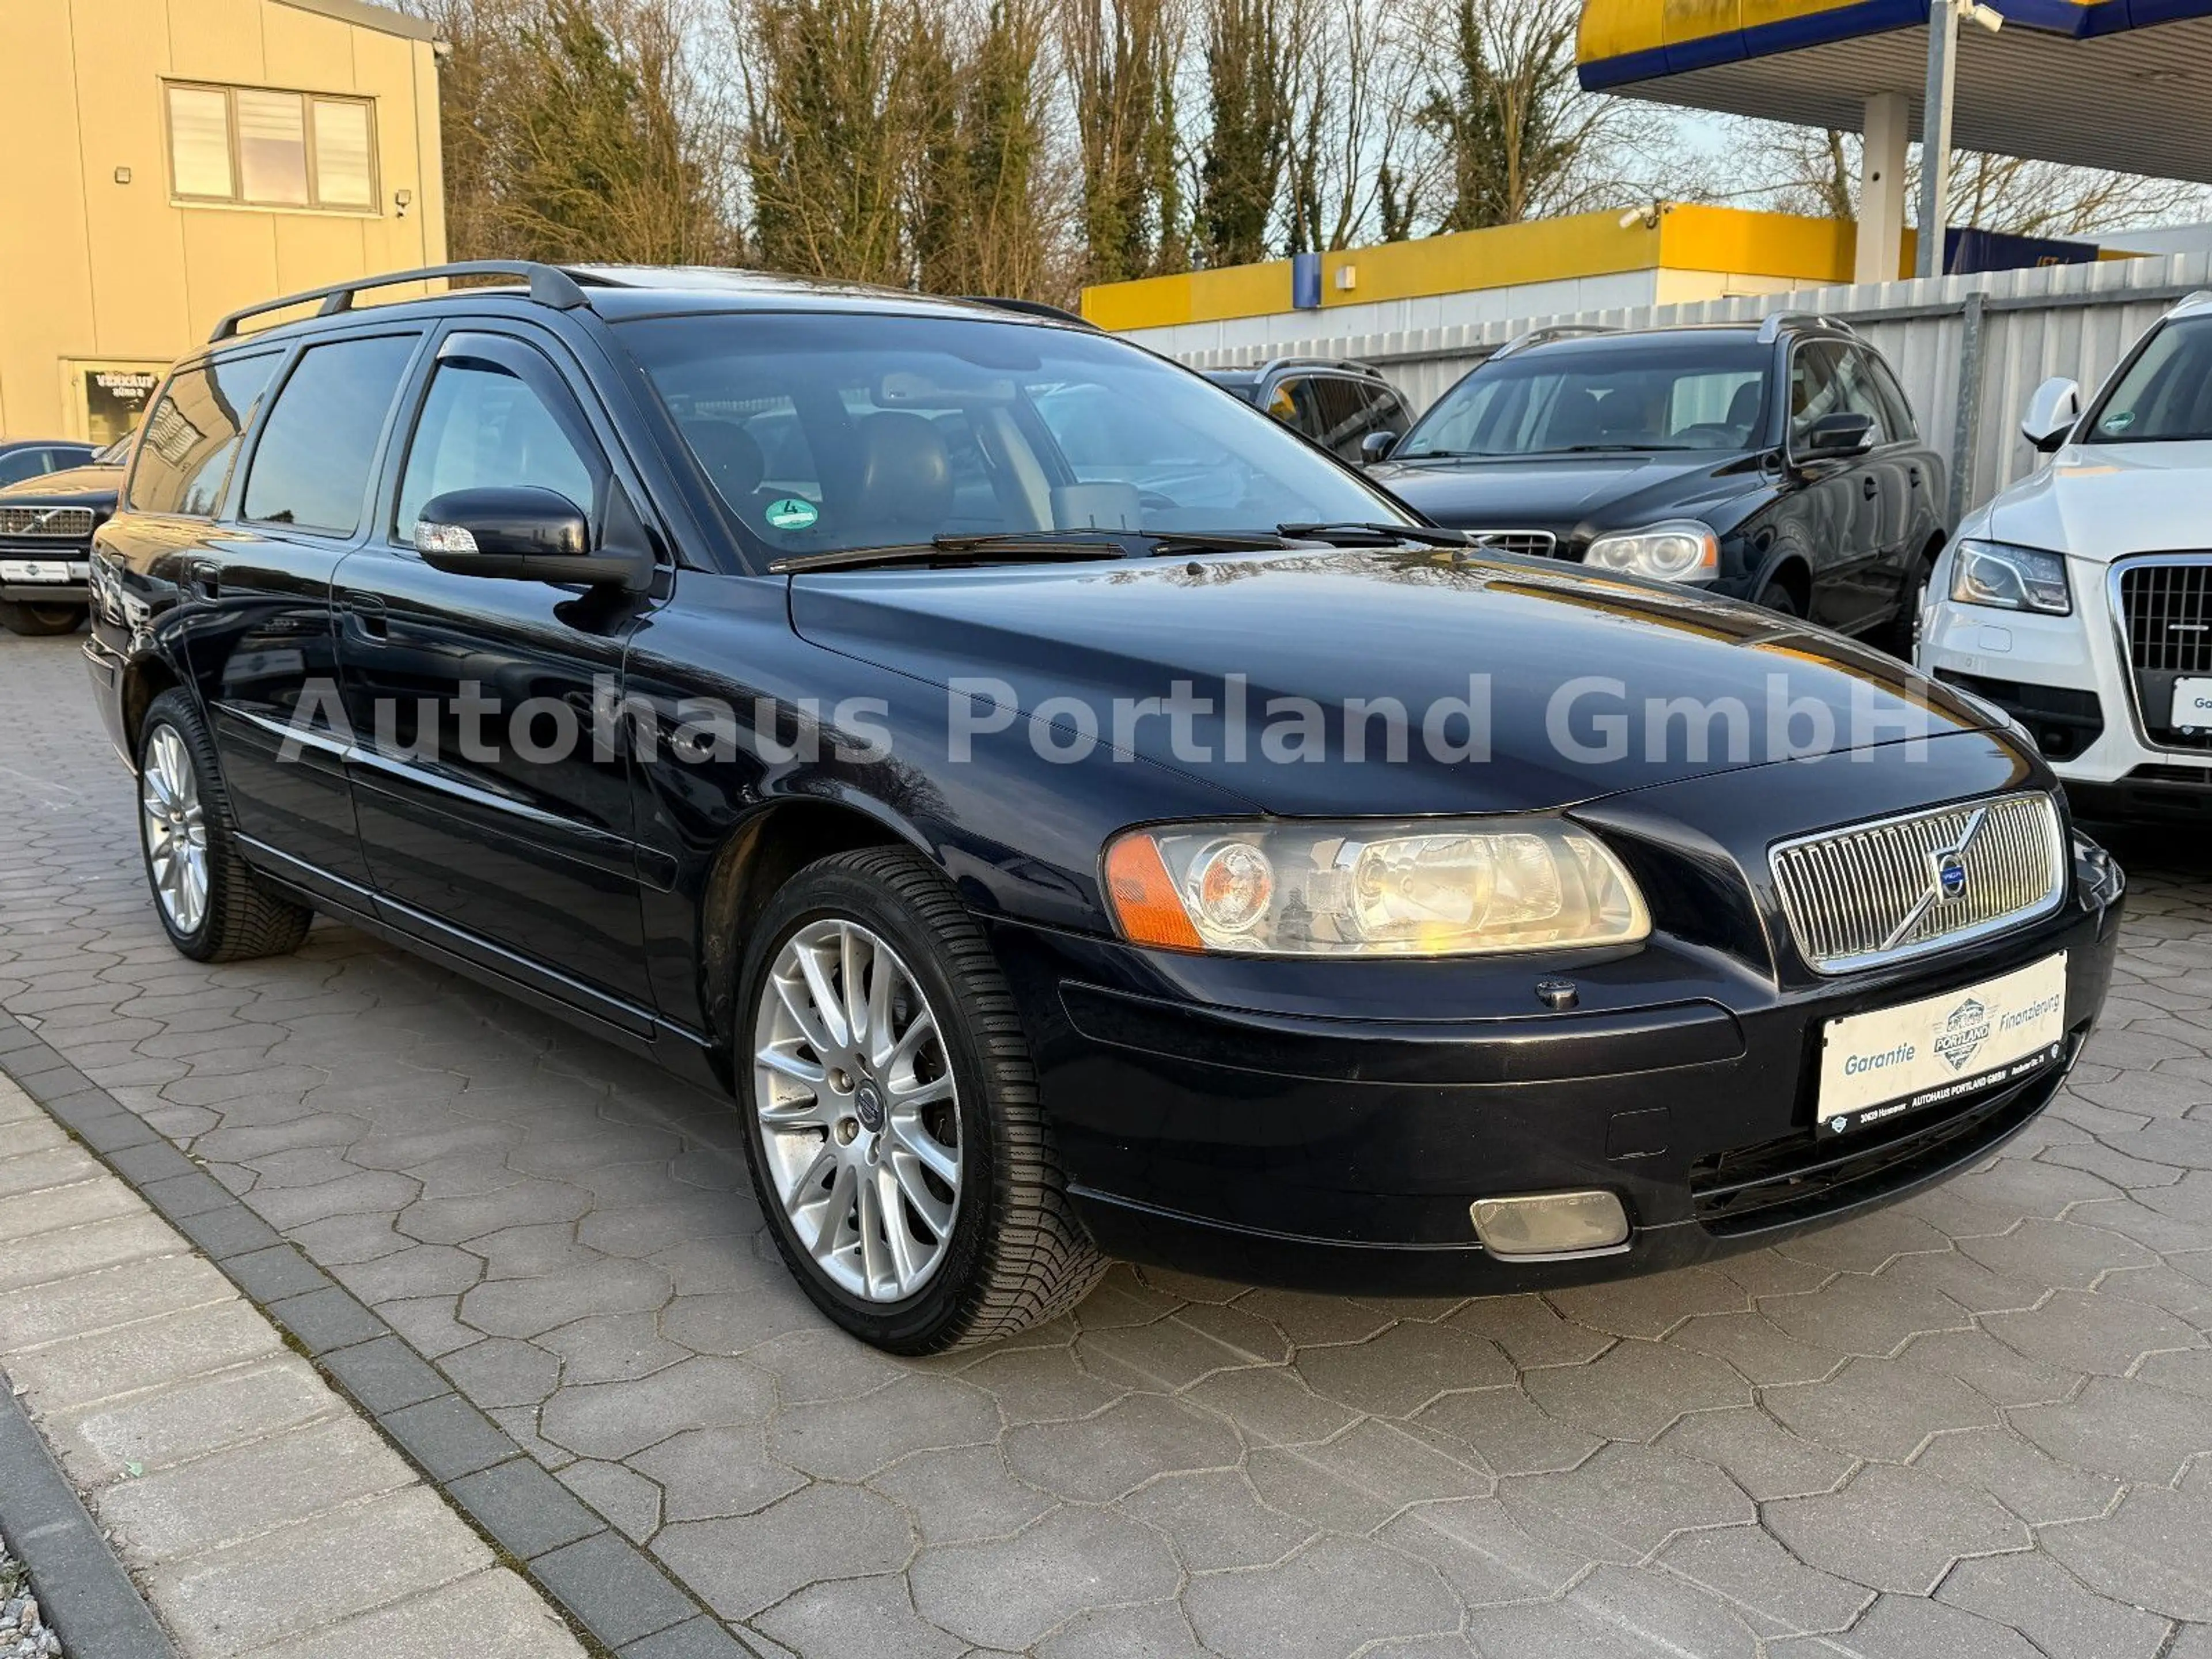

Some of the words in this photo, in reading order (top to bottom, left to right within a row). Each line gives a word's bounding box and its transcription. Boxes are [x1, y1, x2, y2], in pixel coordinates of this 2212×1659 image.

[784, 500, 798, 513] 4
[1999, 994, 2059, 1031] Finanzierung
[1936, 1025, 1988, 1050] PORTLAND
[1844, 1042, 1915, 1075] Garantie
[1911, 1088, 1950, 1108] AUTOHAUS
[1950, 1076, 1986, 1095] PORTLAND
